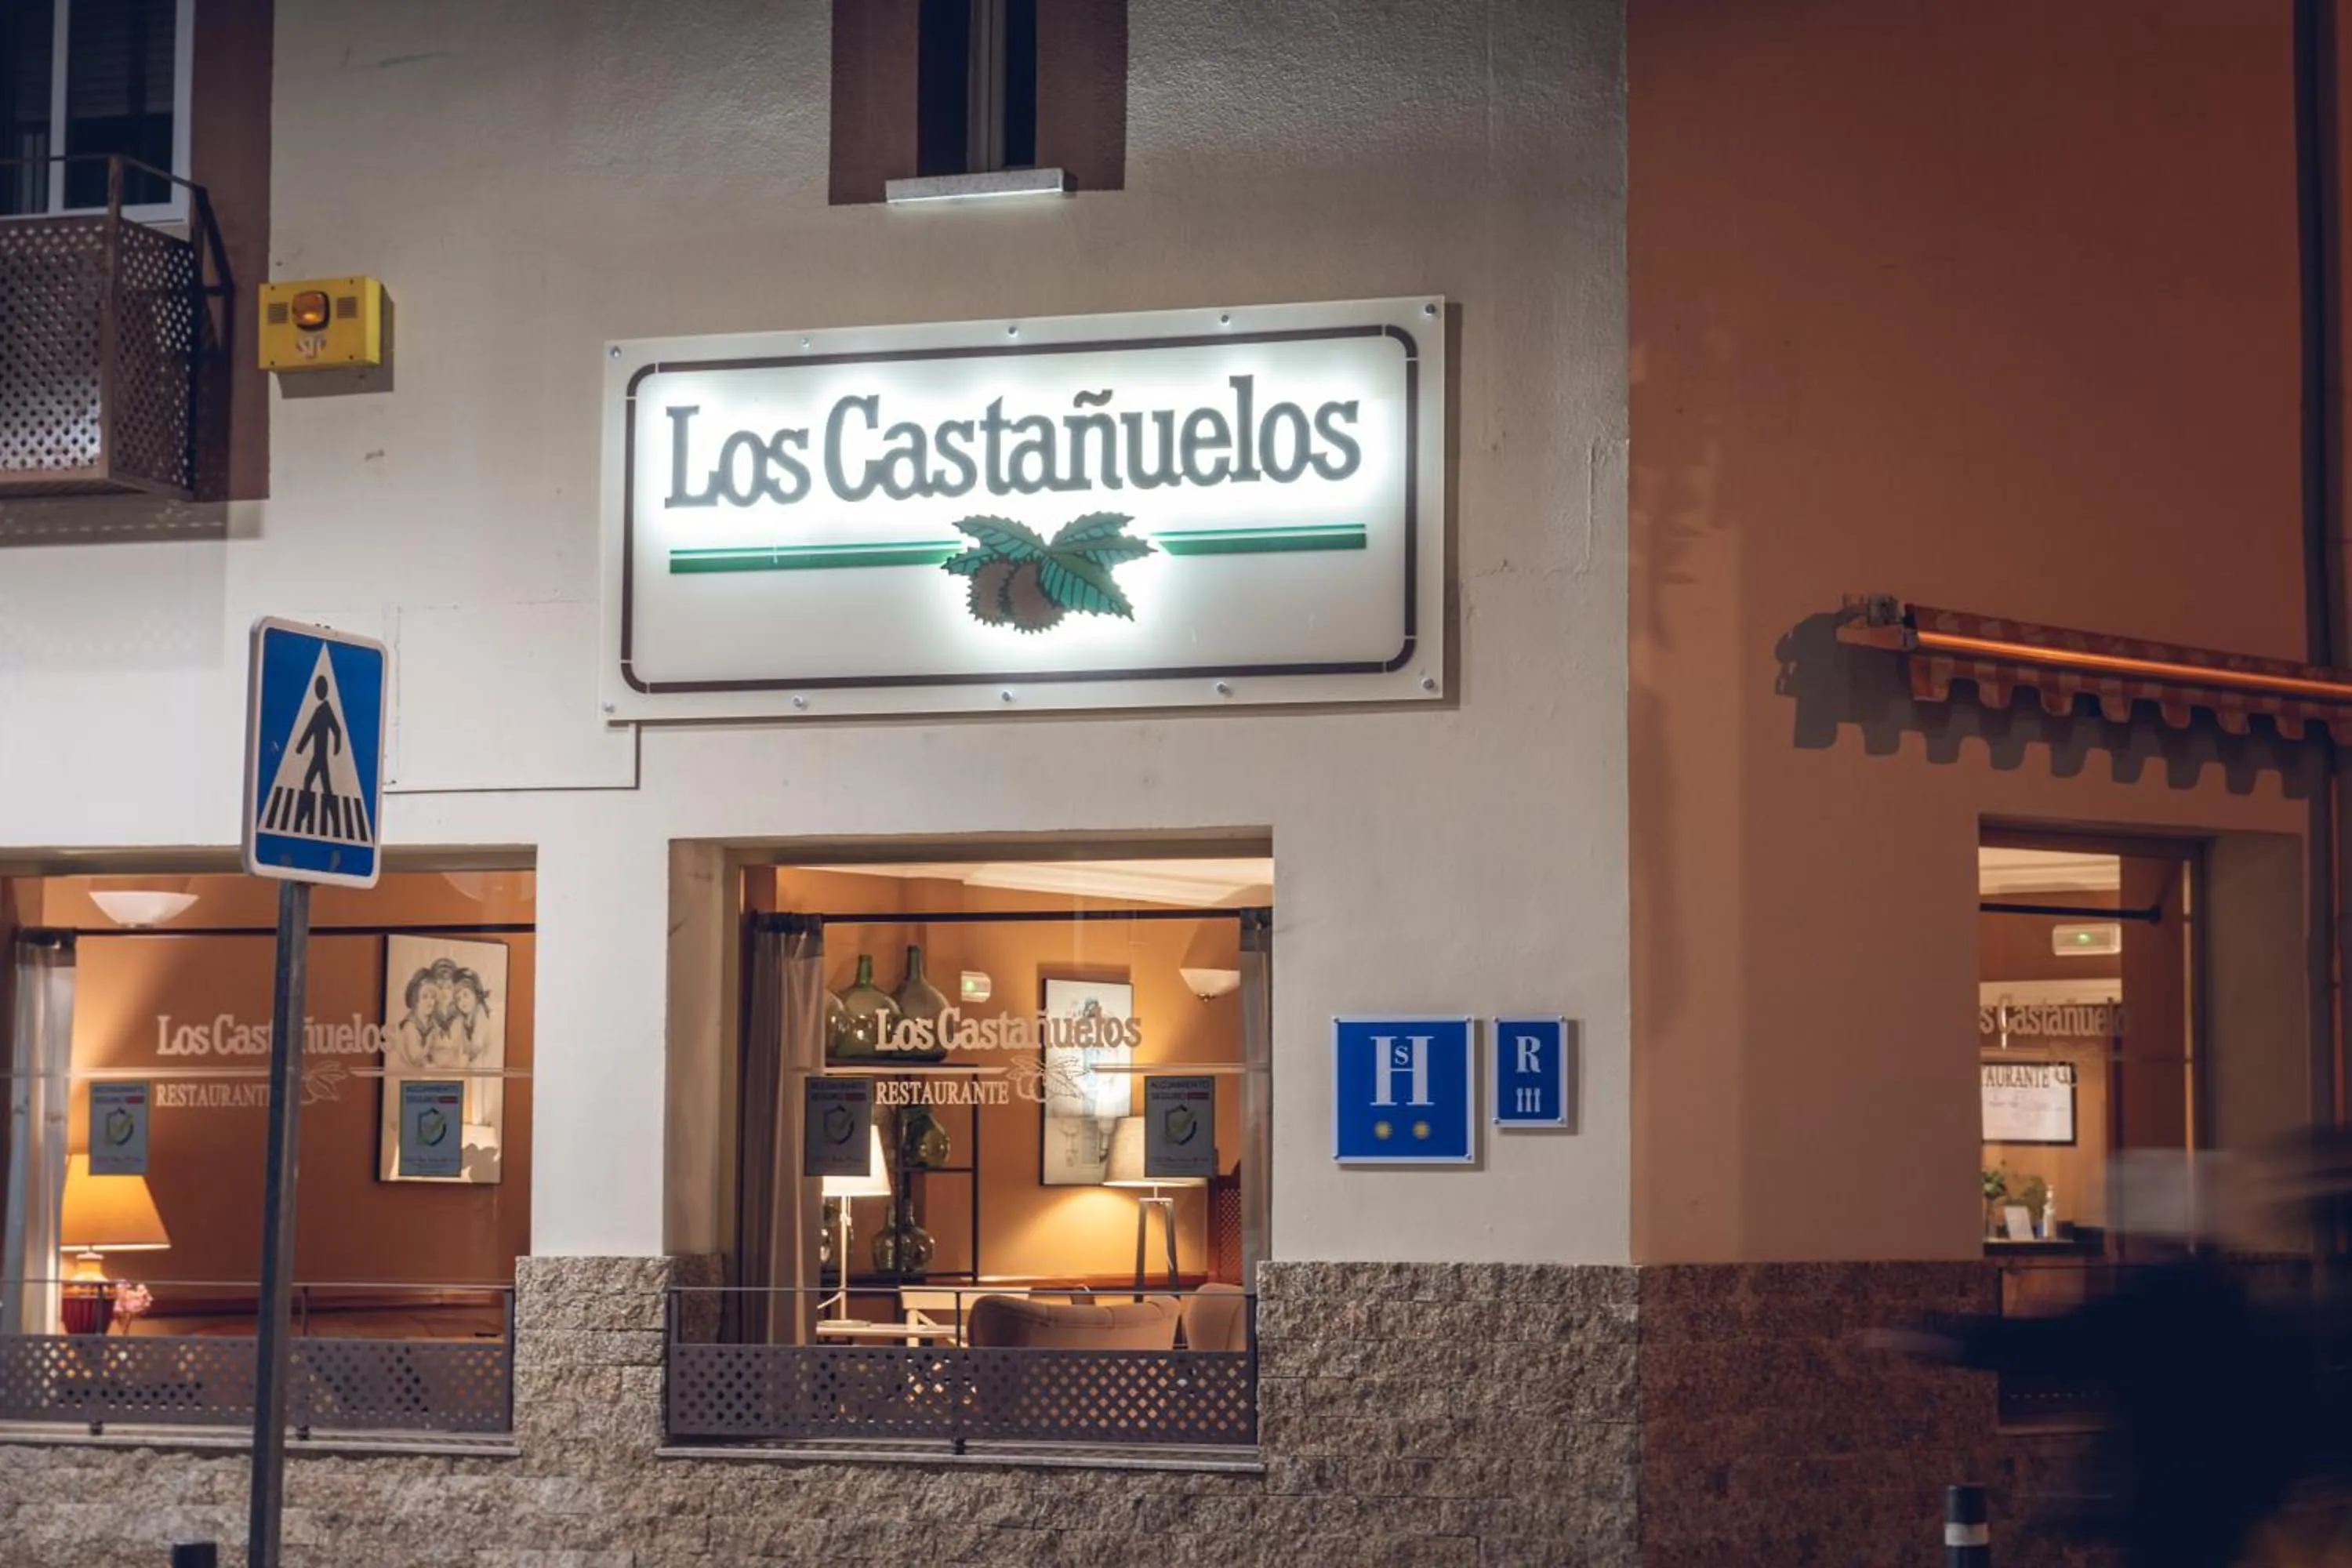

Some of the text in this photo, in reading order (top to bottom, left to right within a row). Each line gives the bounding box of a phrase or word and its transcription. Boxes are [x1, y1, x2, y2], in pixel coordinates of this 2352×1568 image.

[664, 374, 1362, 510] Los Castañuelos
[157, 1013, 396, 1055] Los Casñuelos
[875, 1007, 1142, 1051] Los Castañuelos
[1515, 1035, 1542, 1073] R
[156, 1083, 271, 1108] RESTAURANT
[875, 1081, 1010, 1105] RESTAURANTE
[1981, 1066, 2049, 1088] AURANTE
